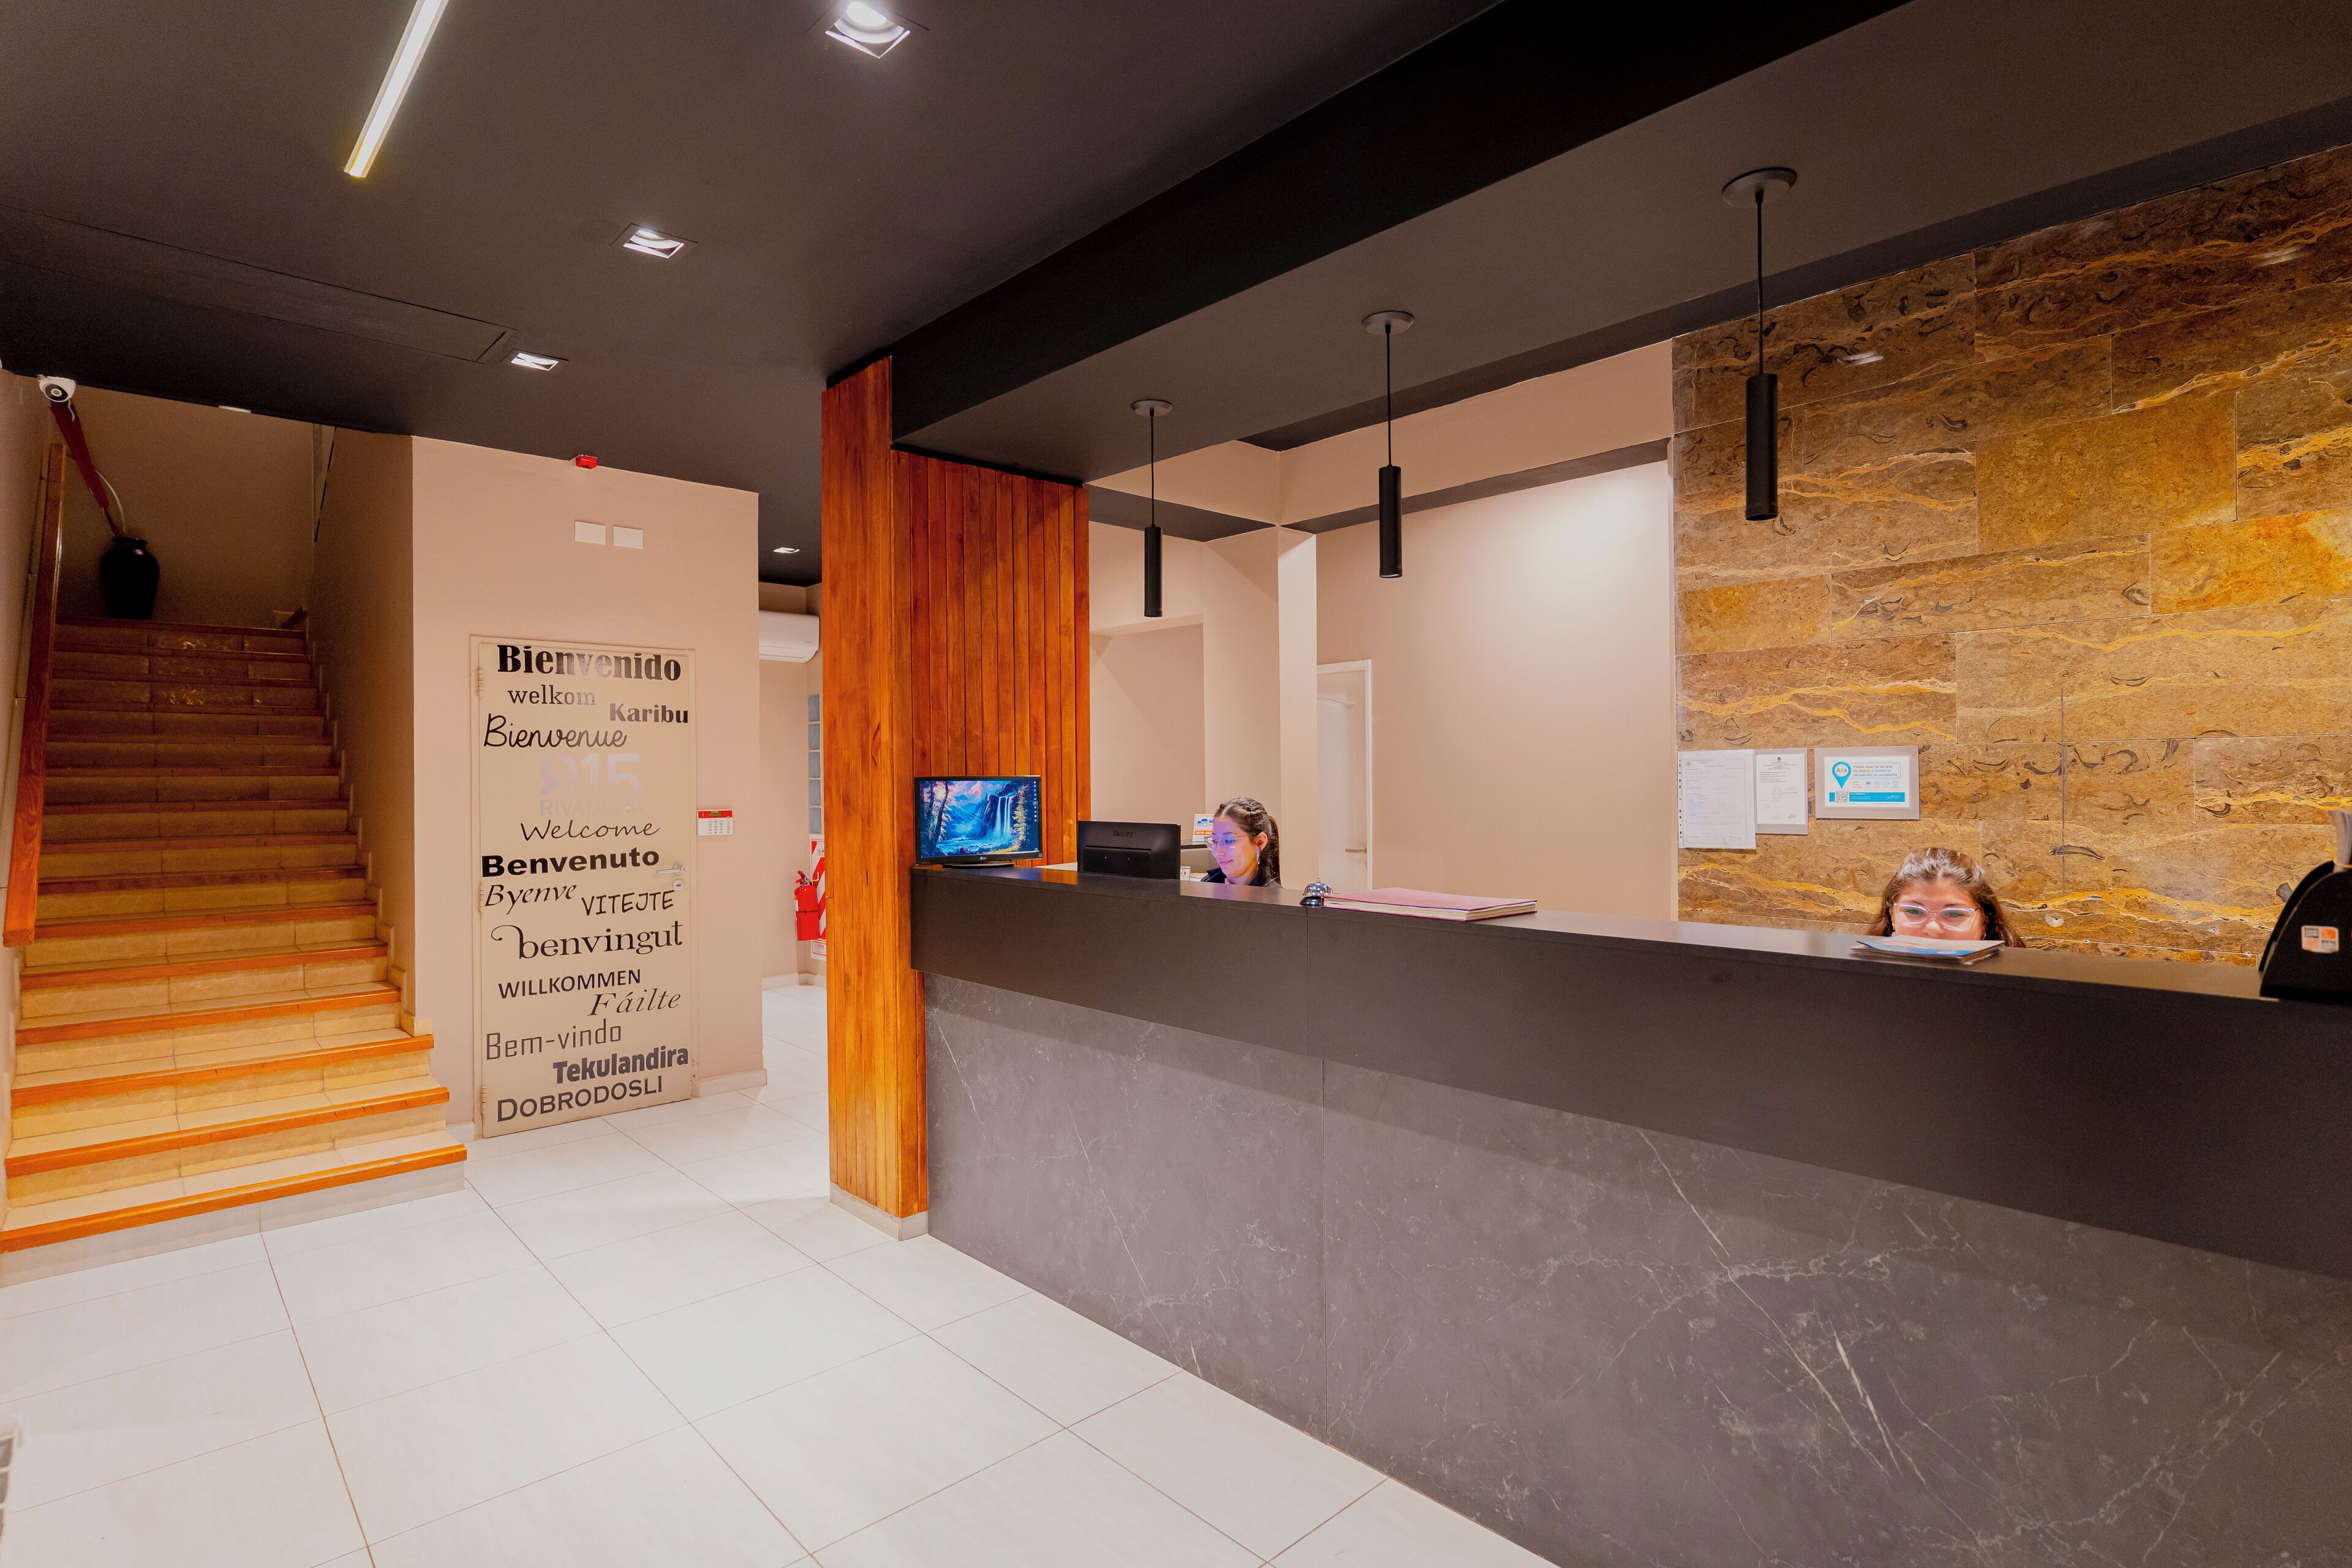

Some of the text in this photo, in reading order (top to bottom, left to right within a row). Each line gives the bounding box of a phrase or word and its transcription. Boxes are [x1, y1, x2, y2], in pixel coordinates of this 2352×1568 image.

[497, 644, 682, 681] Bienvenido
[507, 684, 597, 706] welkom
[609, 703, 688, 723] Karibu
[484, 713, 628, 748] Bienvenue
[520, 820, 661, 842] Welcome
[482, 847, 660, 877] Benvenuto
[484, 884, 577, 915] Byenve
[581, 890, 675, 916] VITEJTE
[491, 921, 683, 959] benvingut
[498, 969, 641, 998] WILLKOMMEN
[586, 988, 681, 1016] Fáilte
[486, 1019, 622, 1060] Bem-vindo
[552, 1046, 688, 1084] Tekulandira
[497, 1076, 663, 1123] DOBRODOSLI
